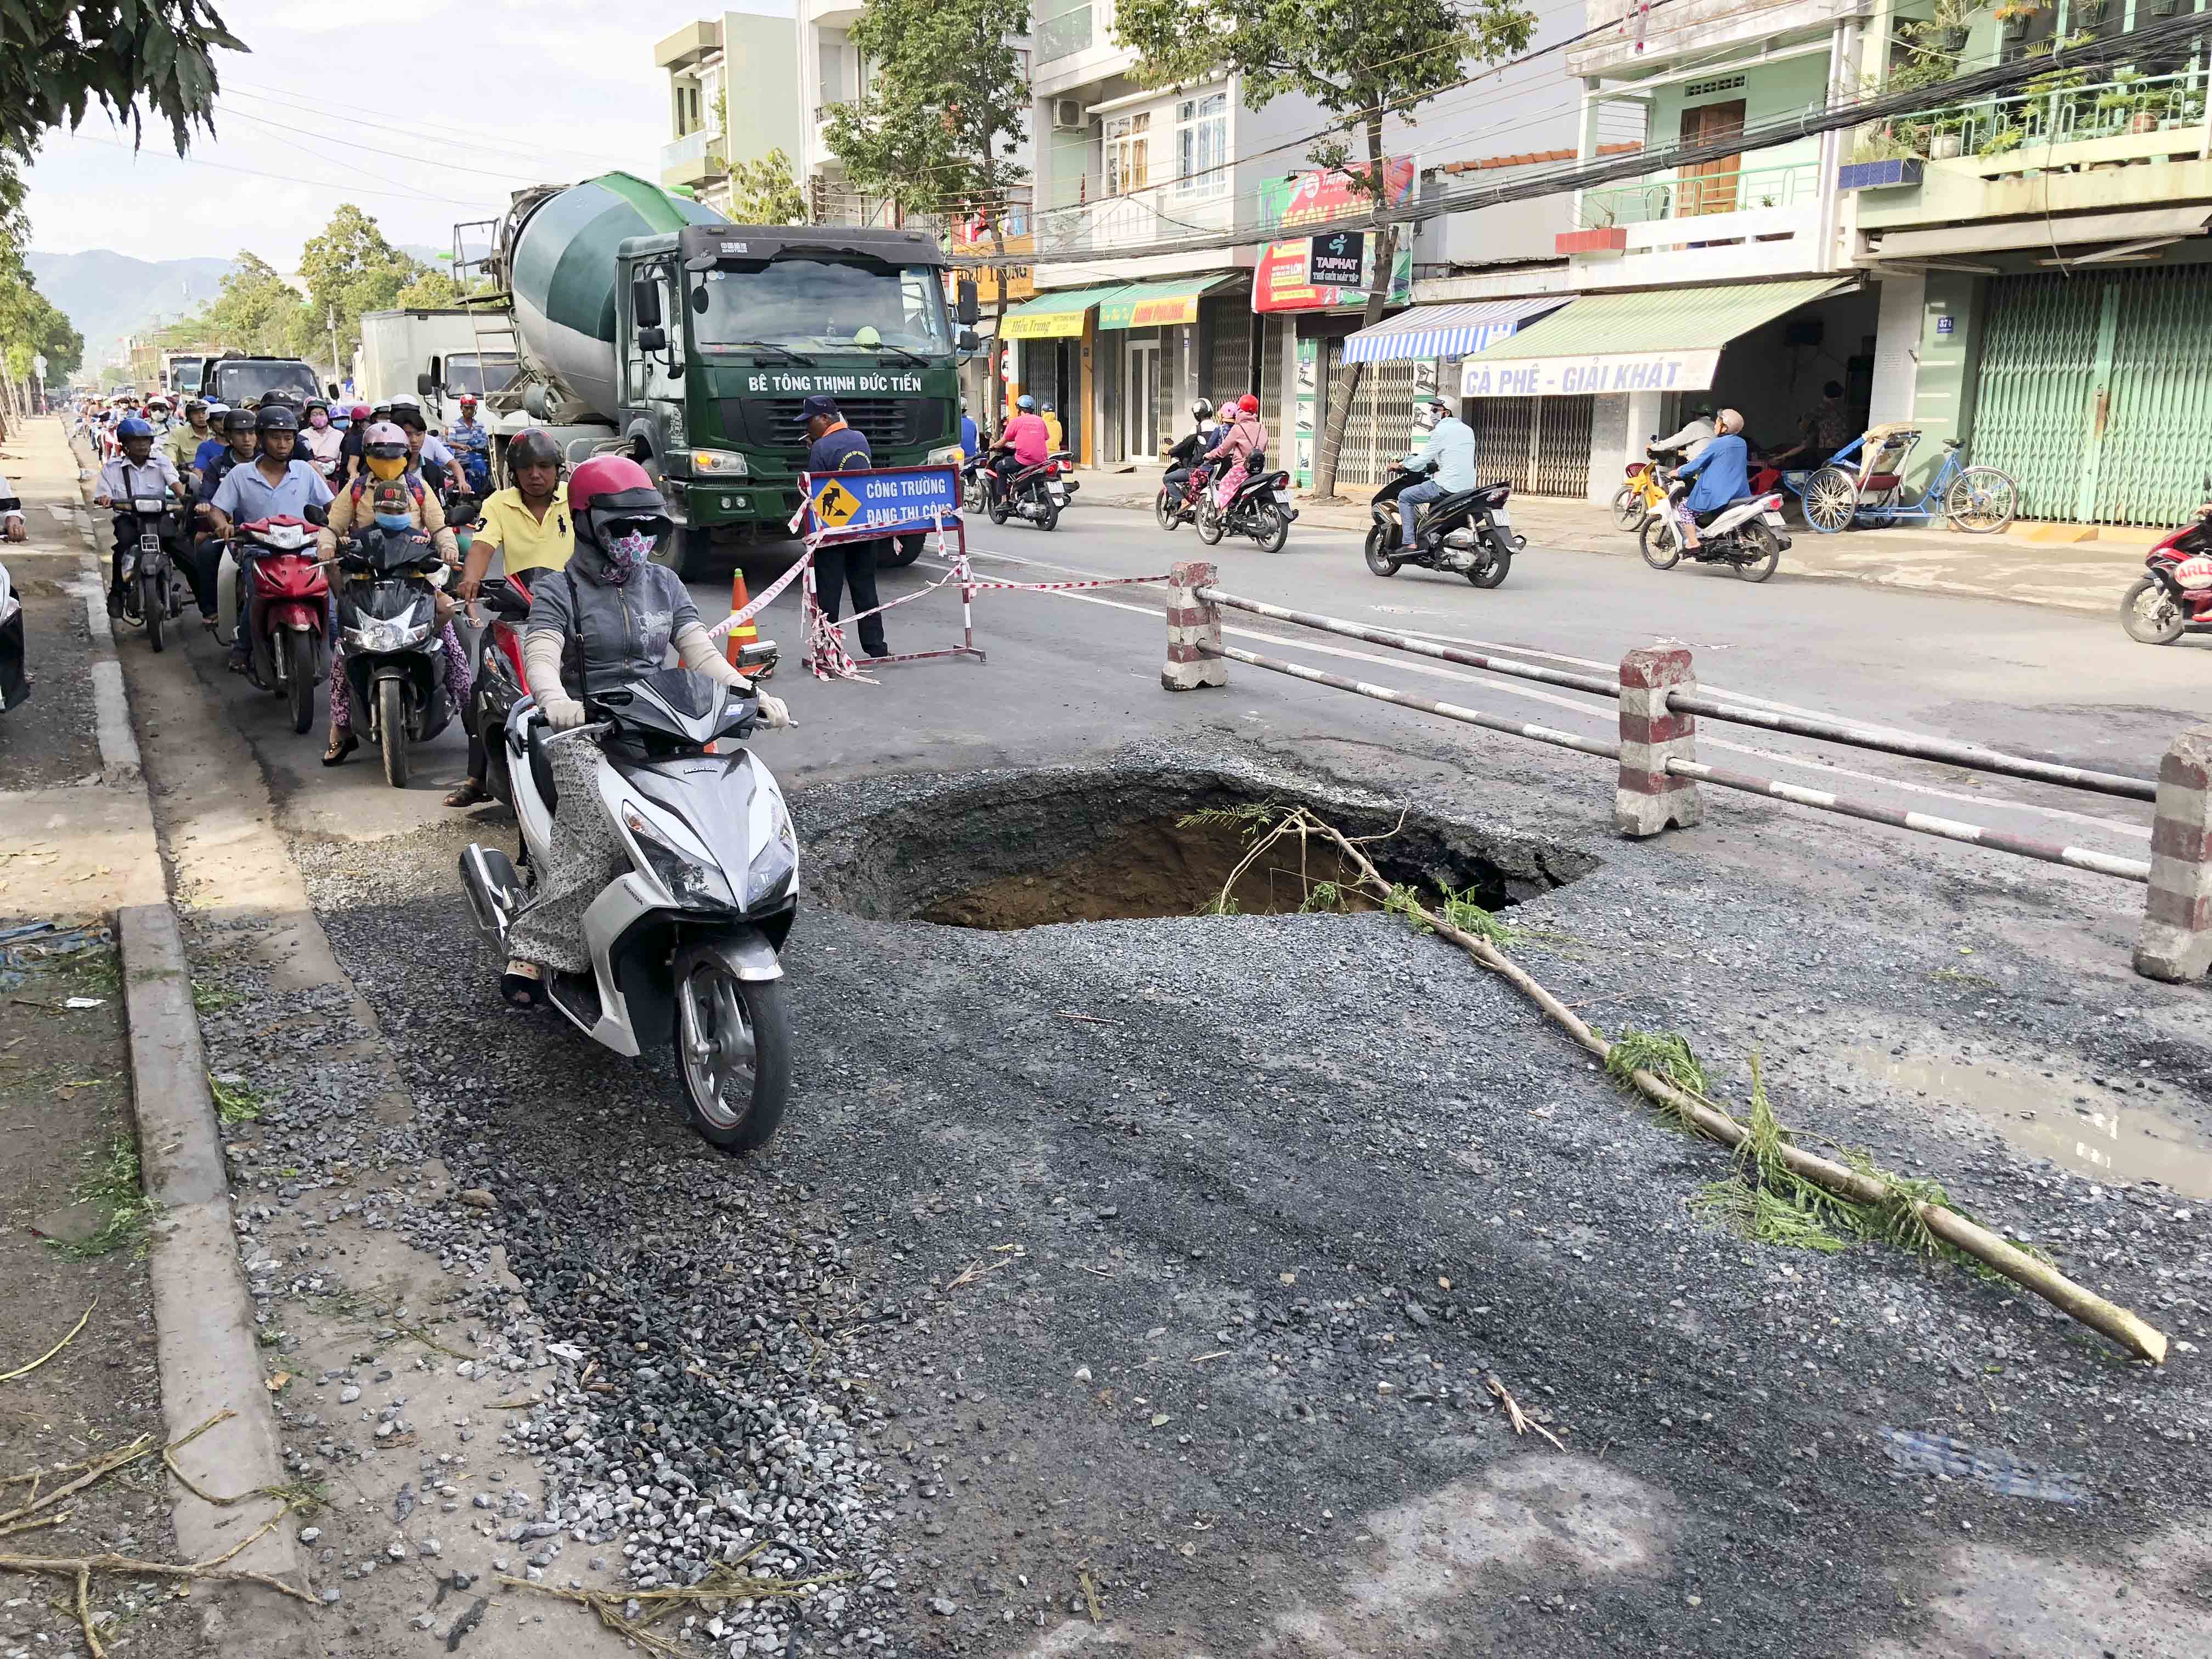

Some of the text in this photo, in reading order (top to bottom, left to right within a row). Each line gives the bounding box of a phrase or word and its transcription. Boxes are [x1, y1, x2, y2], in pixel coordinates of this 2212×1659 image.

[749, 372, 922, 394] BÊ TÔNG THỊNH ĐỨC TIẾN
[1466, 365, 1491, 395] CÀ
[1498, 363, 1540, 394] PHÊ
[1562, 357, 1610, 392] GIẢI
[1613, 357, 1682, 390] KHÁT
[866, 476, 946, 499] CÔNG TRƯỜNG
[475, 517, 488, 532] 3
[623, 883, 642, 906] HONDA
